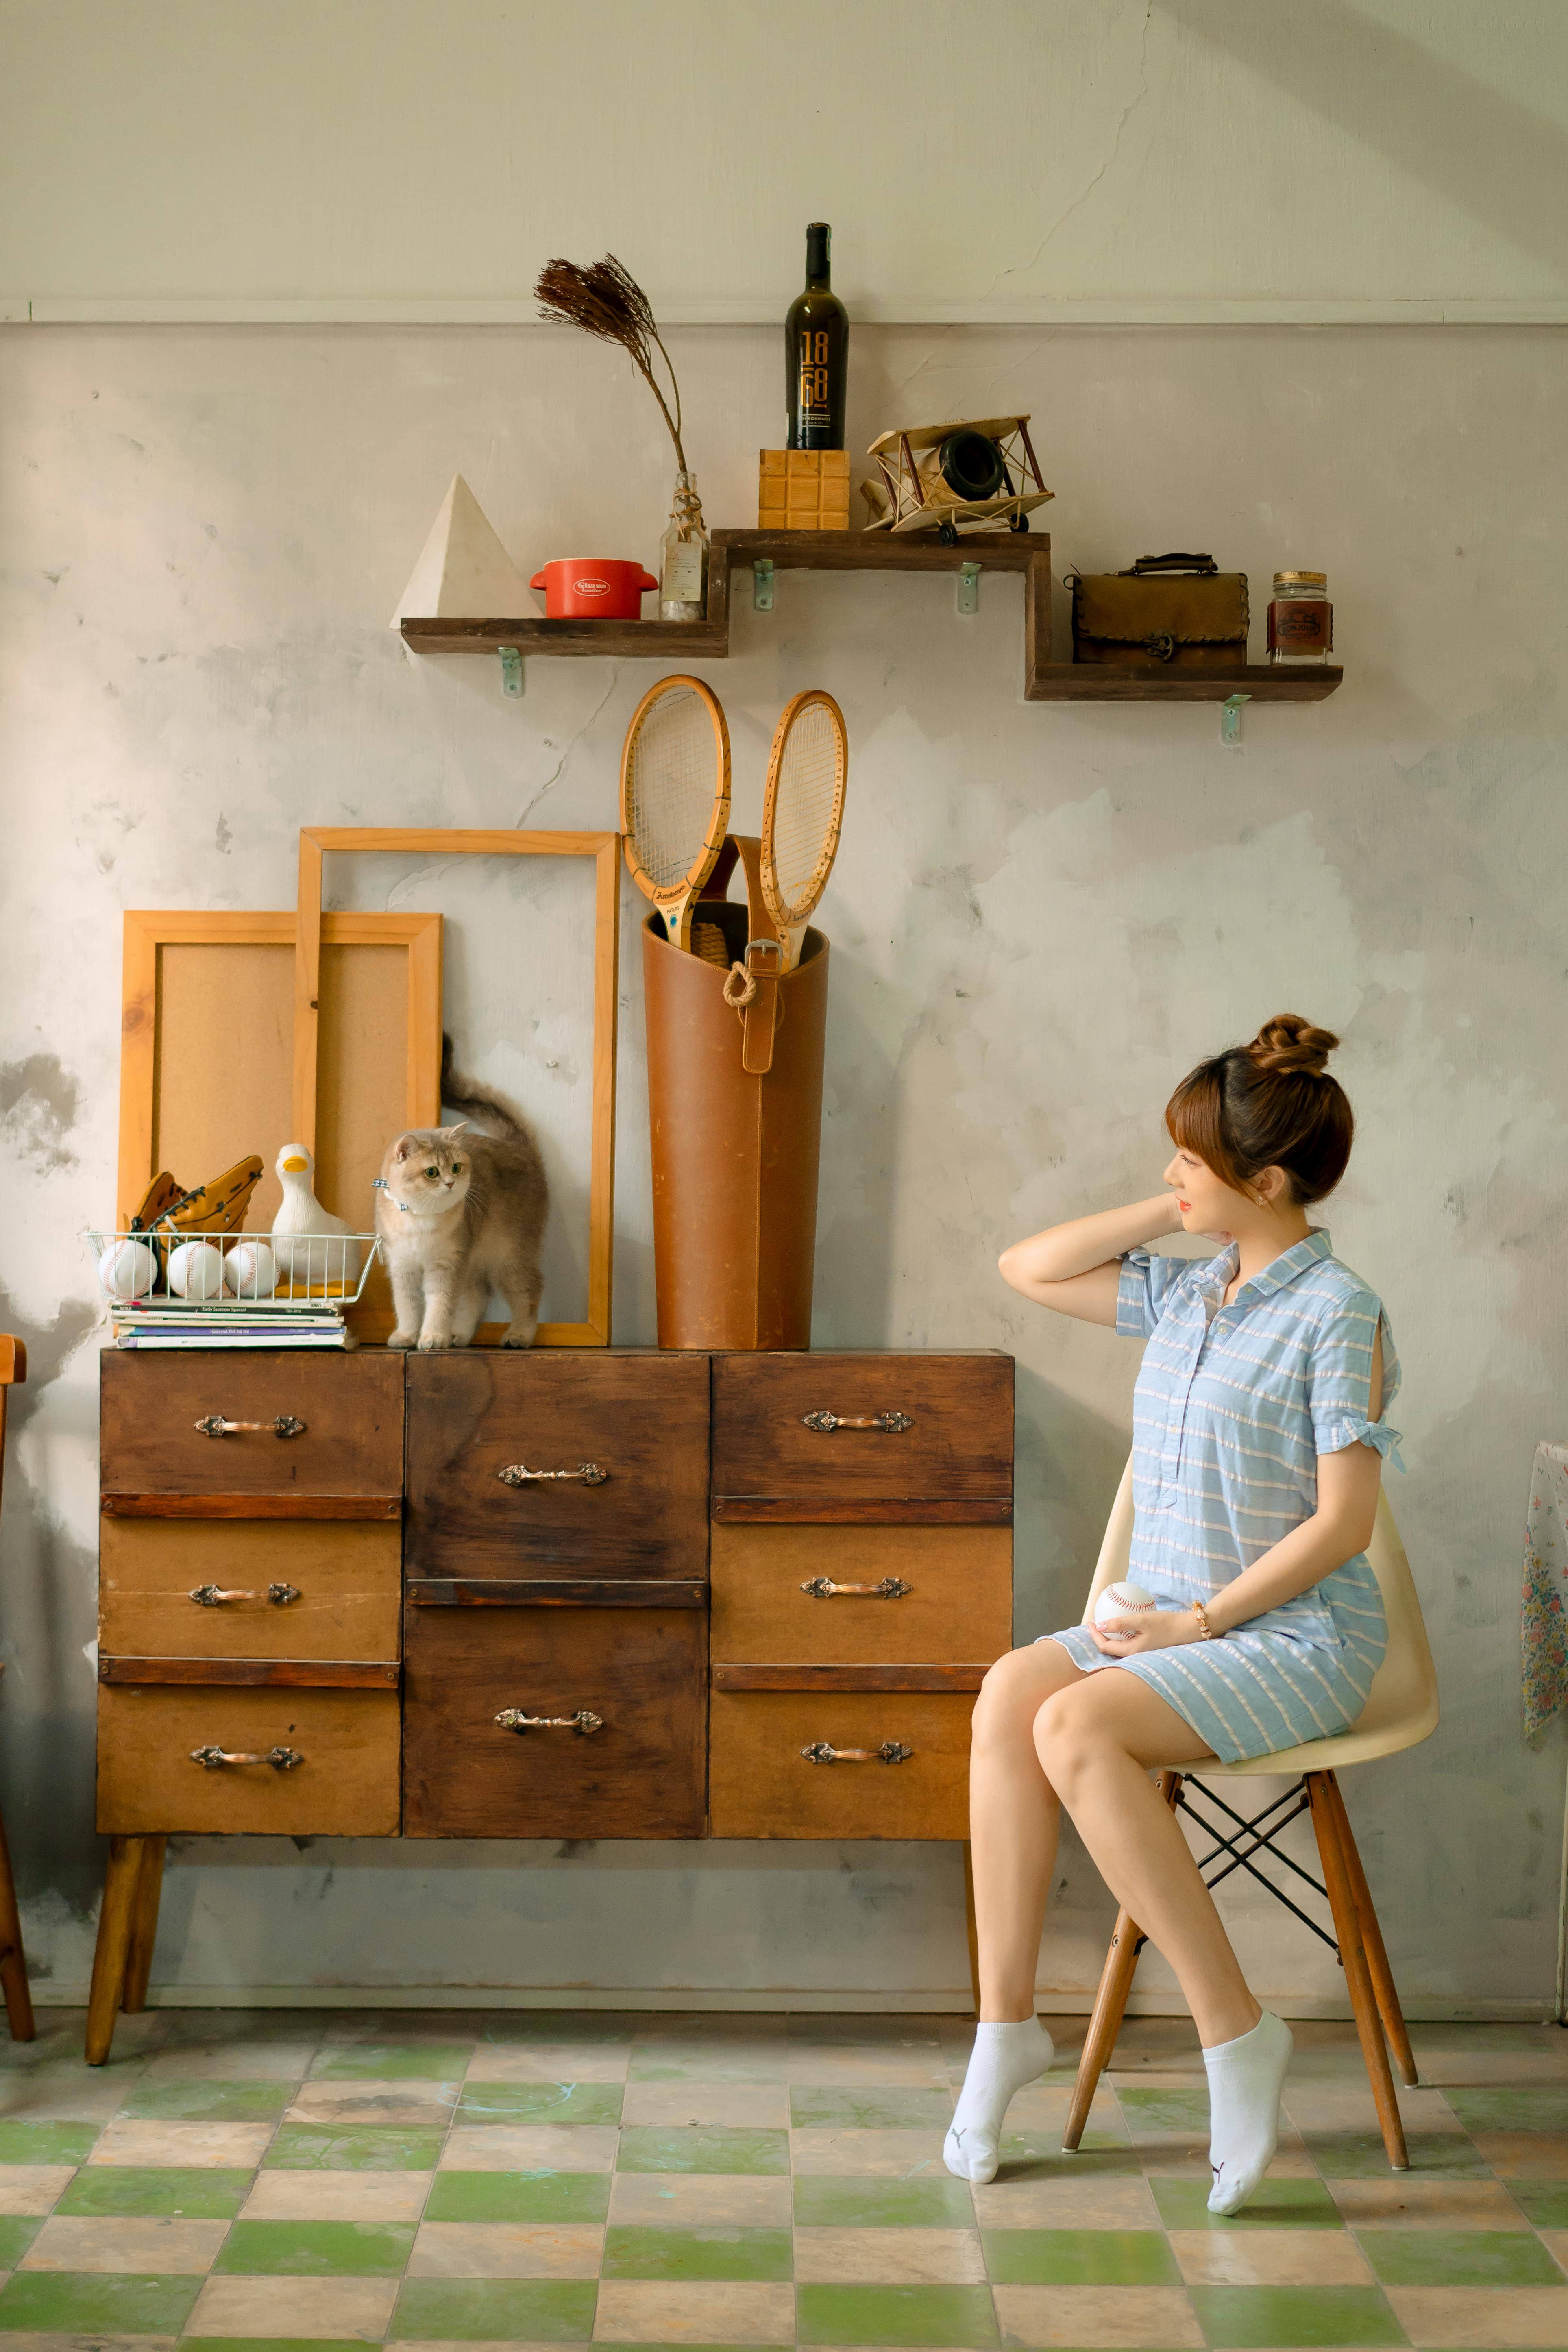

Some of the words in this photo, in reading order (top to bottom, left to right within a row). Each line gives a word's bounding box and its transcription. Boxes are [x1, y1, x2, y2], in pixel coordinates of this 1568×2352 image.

[801, 331, 828, 365] 18
[800, 368, 828, 408] 68
[667, 906, 680, 914] NATURE
